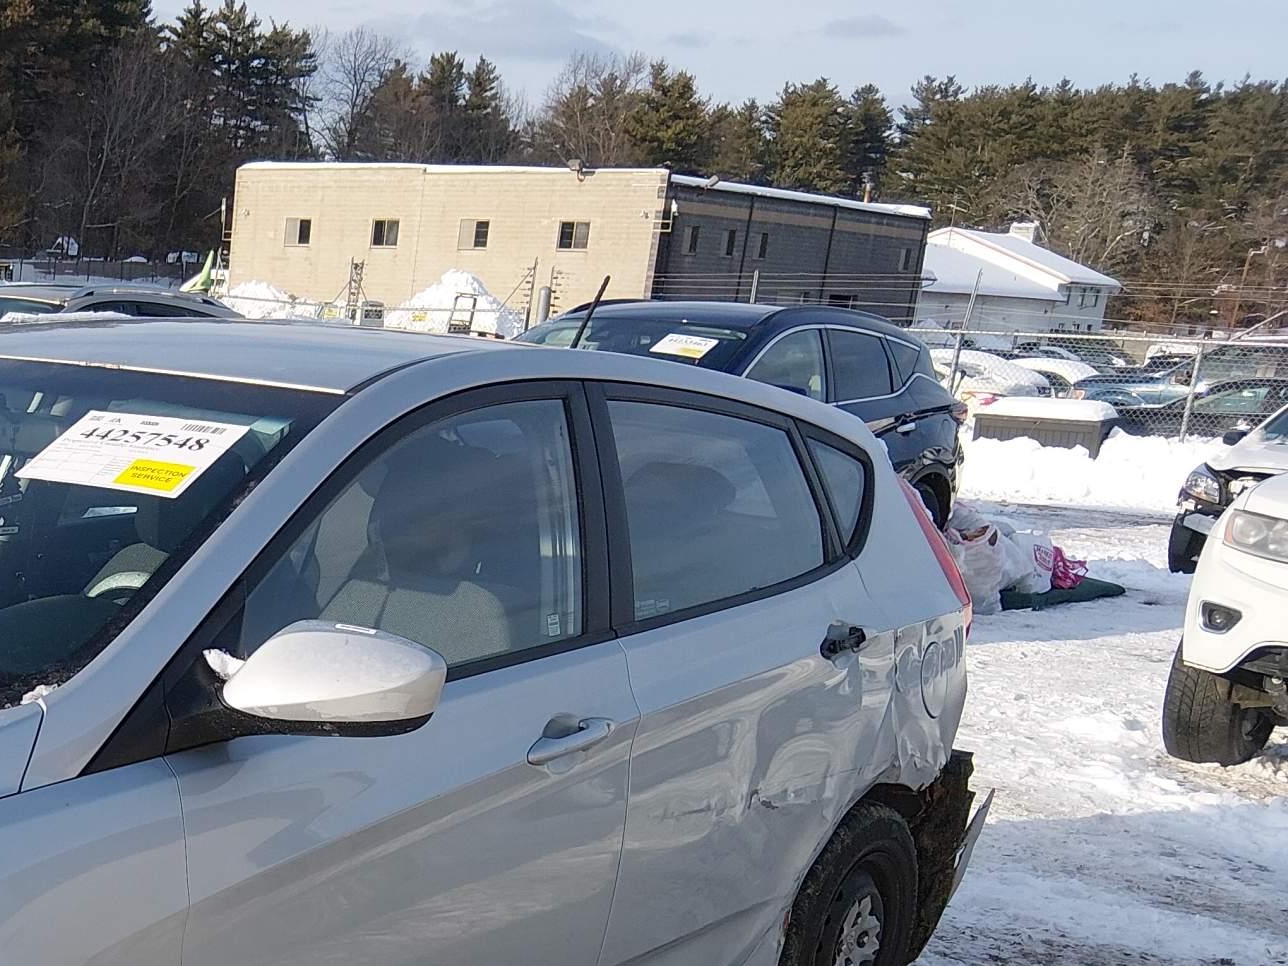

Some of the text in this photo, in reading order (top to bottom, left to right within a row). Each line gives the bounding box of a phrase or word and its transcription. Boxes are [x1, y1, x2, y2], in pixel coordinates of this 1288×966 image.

[79, 426, 210, 452] 44257548
[130, 465, 187, 478] INSPECTION
[130, 472, 172, 483] SERVICE
